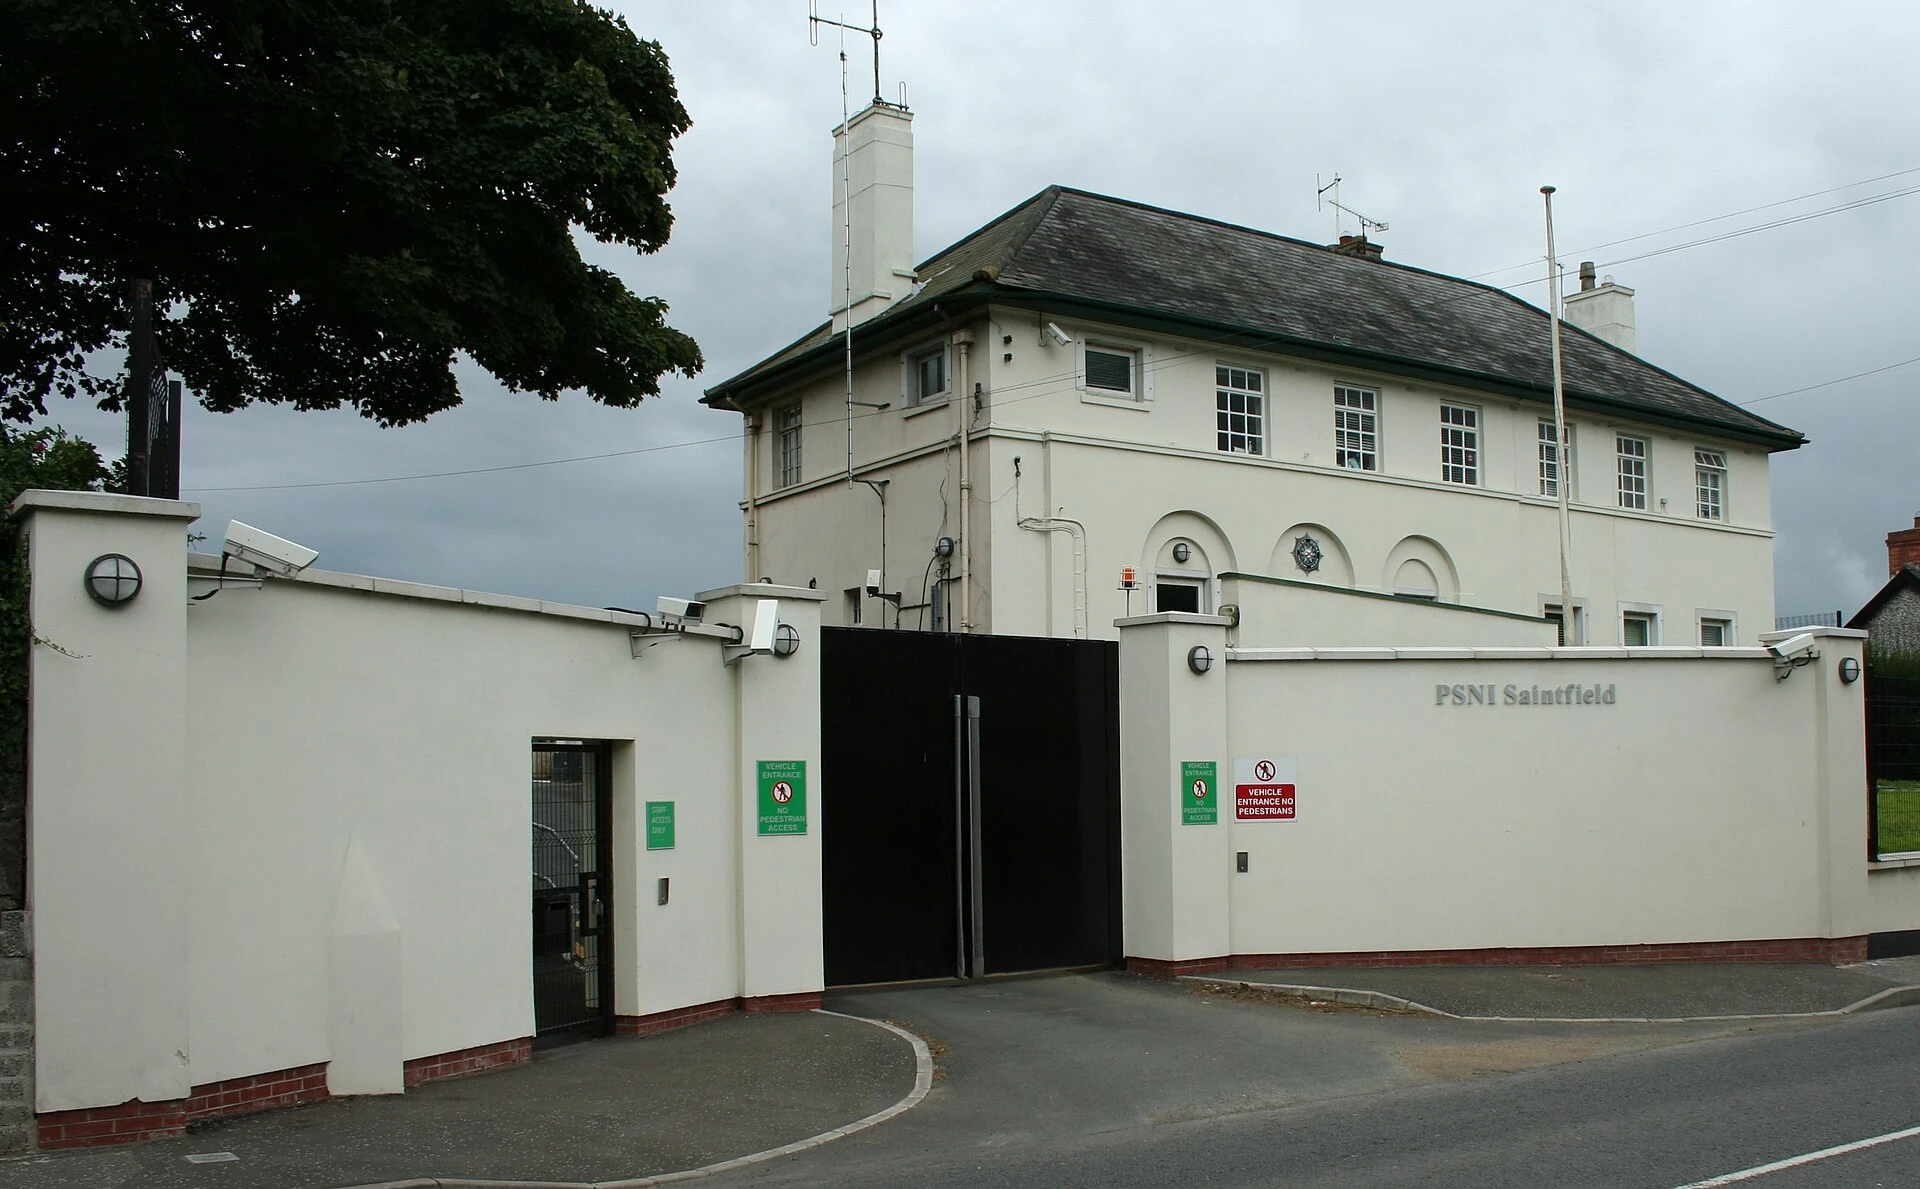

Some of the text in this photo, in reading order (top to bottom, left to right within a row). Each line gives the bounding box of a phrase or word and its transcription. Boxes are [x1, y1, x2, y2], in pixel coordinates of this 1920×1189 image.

[1435, 683, 1616, 705] PSNI Saintfield
[762, 771, 802, 779] ENTRANCE
[1281, 797, 1294, 805] NO
[1239, 807, 1293, 815] PEDESTRIANS
[760, 815, 805, 823] PEDESTRIAN
[768, 824, 798, 832] ACCESS
